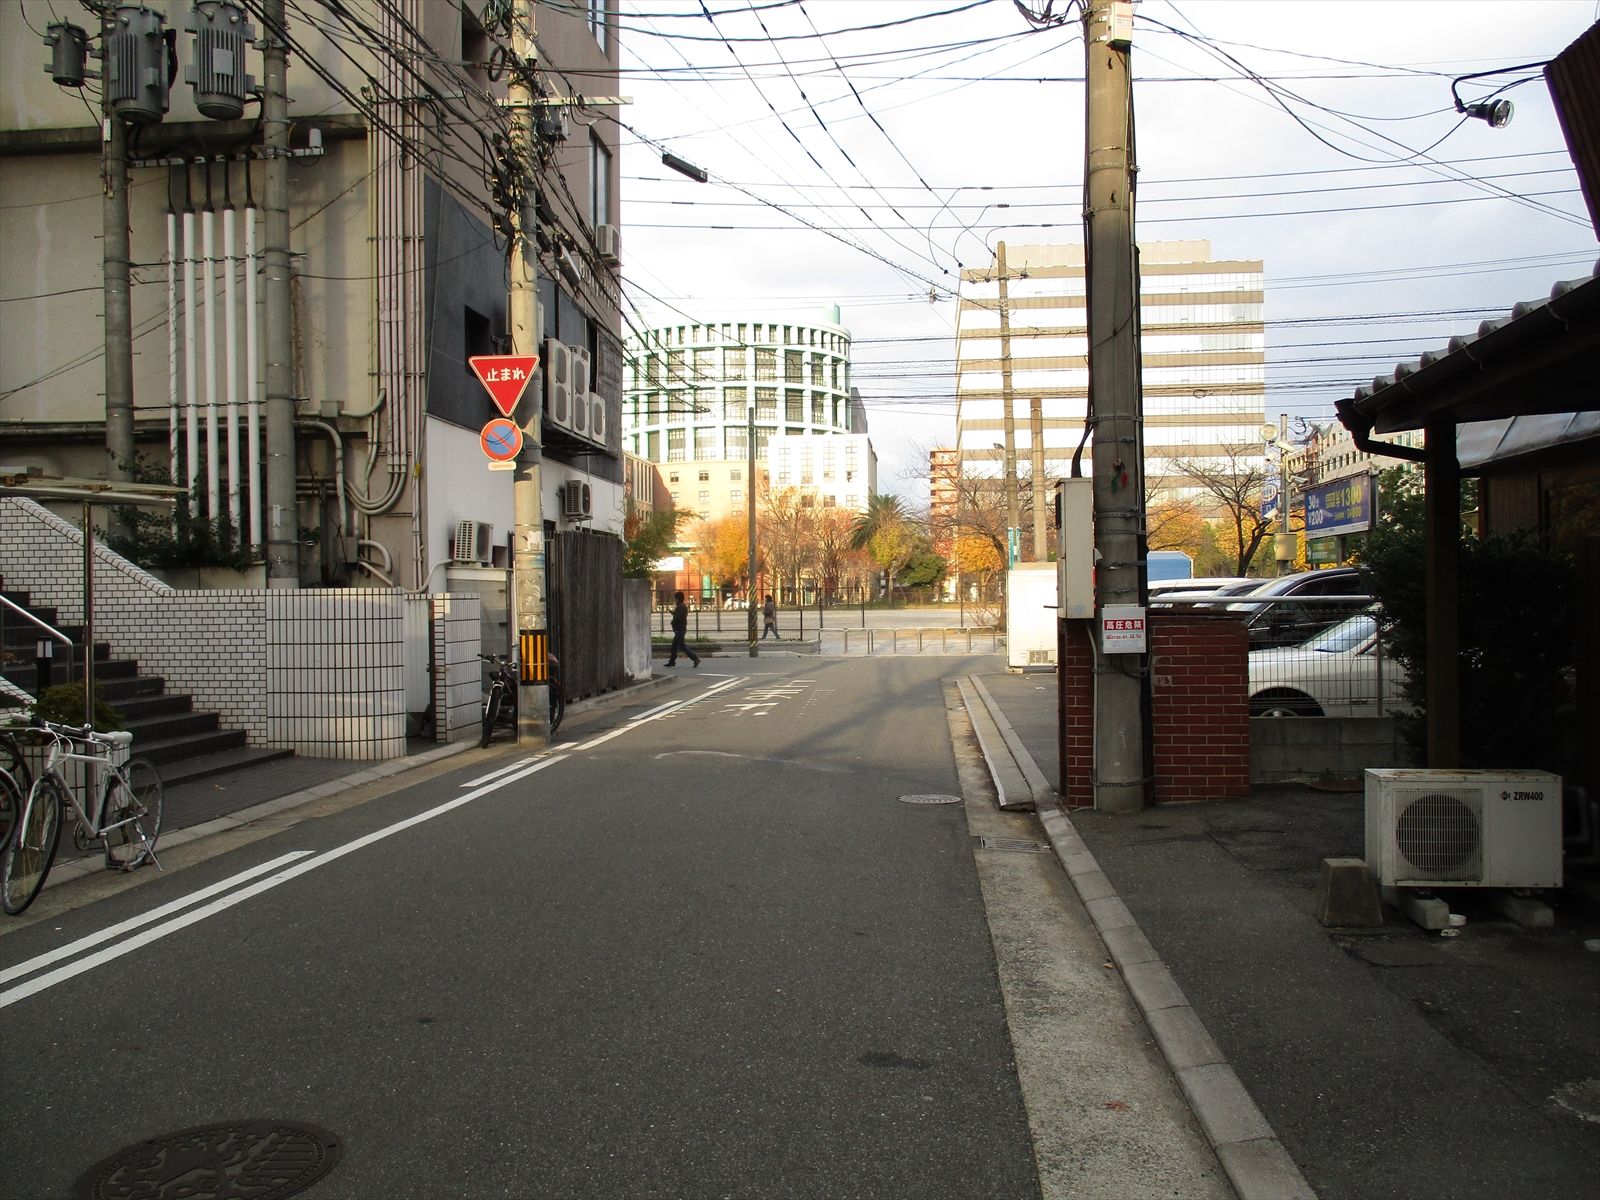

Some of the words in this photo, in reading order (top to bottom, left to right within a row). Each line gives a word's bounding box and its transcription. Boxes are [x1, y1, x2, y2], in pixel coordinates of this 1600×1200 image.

[486, 367, 526, 381] 止まれ
[1106, 620, 1142, 630] 高圧危険
[1513, 791, 1543, 801] ZRW400
